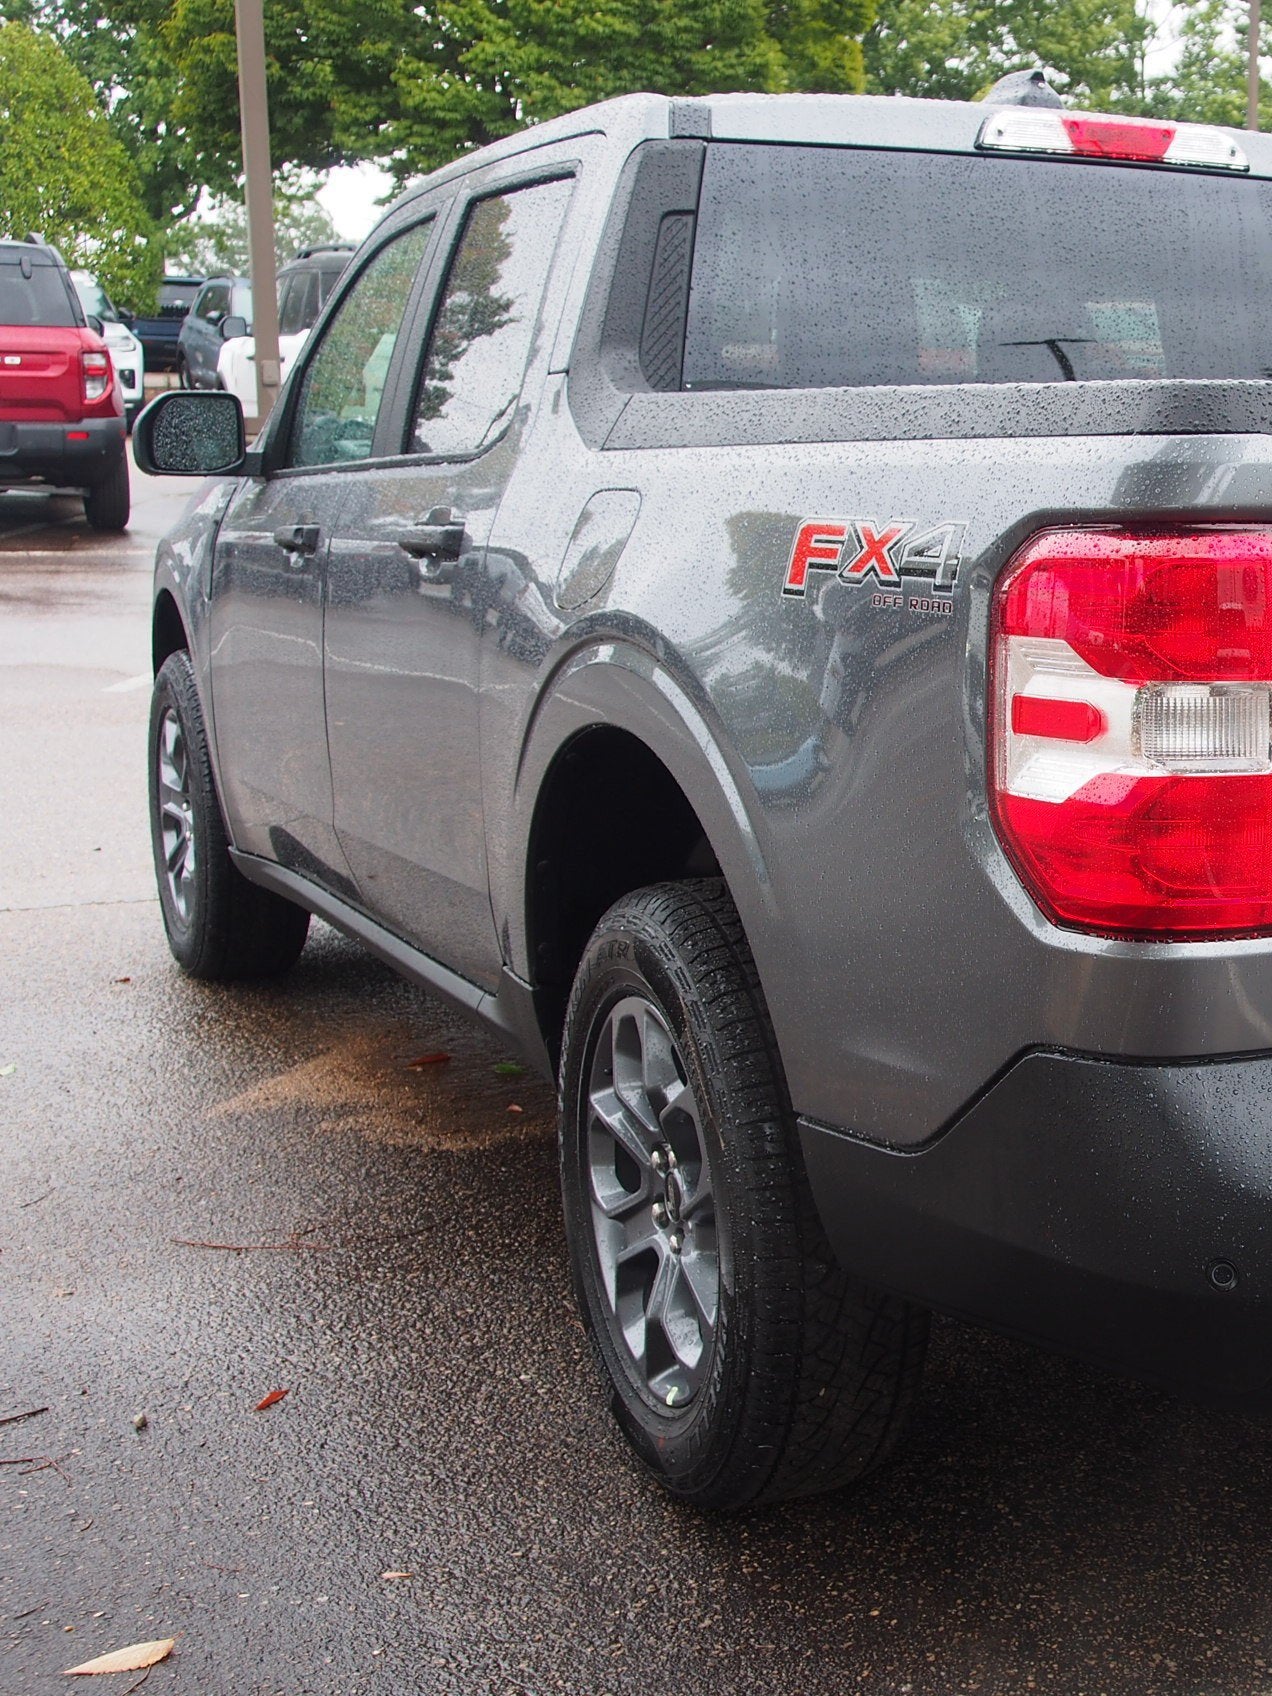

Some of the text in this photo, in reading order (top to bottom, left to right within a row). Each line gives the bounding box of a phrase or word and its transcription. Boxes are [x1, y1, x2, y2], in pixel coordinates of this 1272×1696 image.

[781, 515, 970, 598] FX4
[872, 593, 954, 614] OFF ROAD
